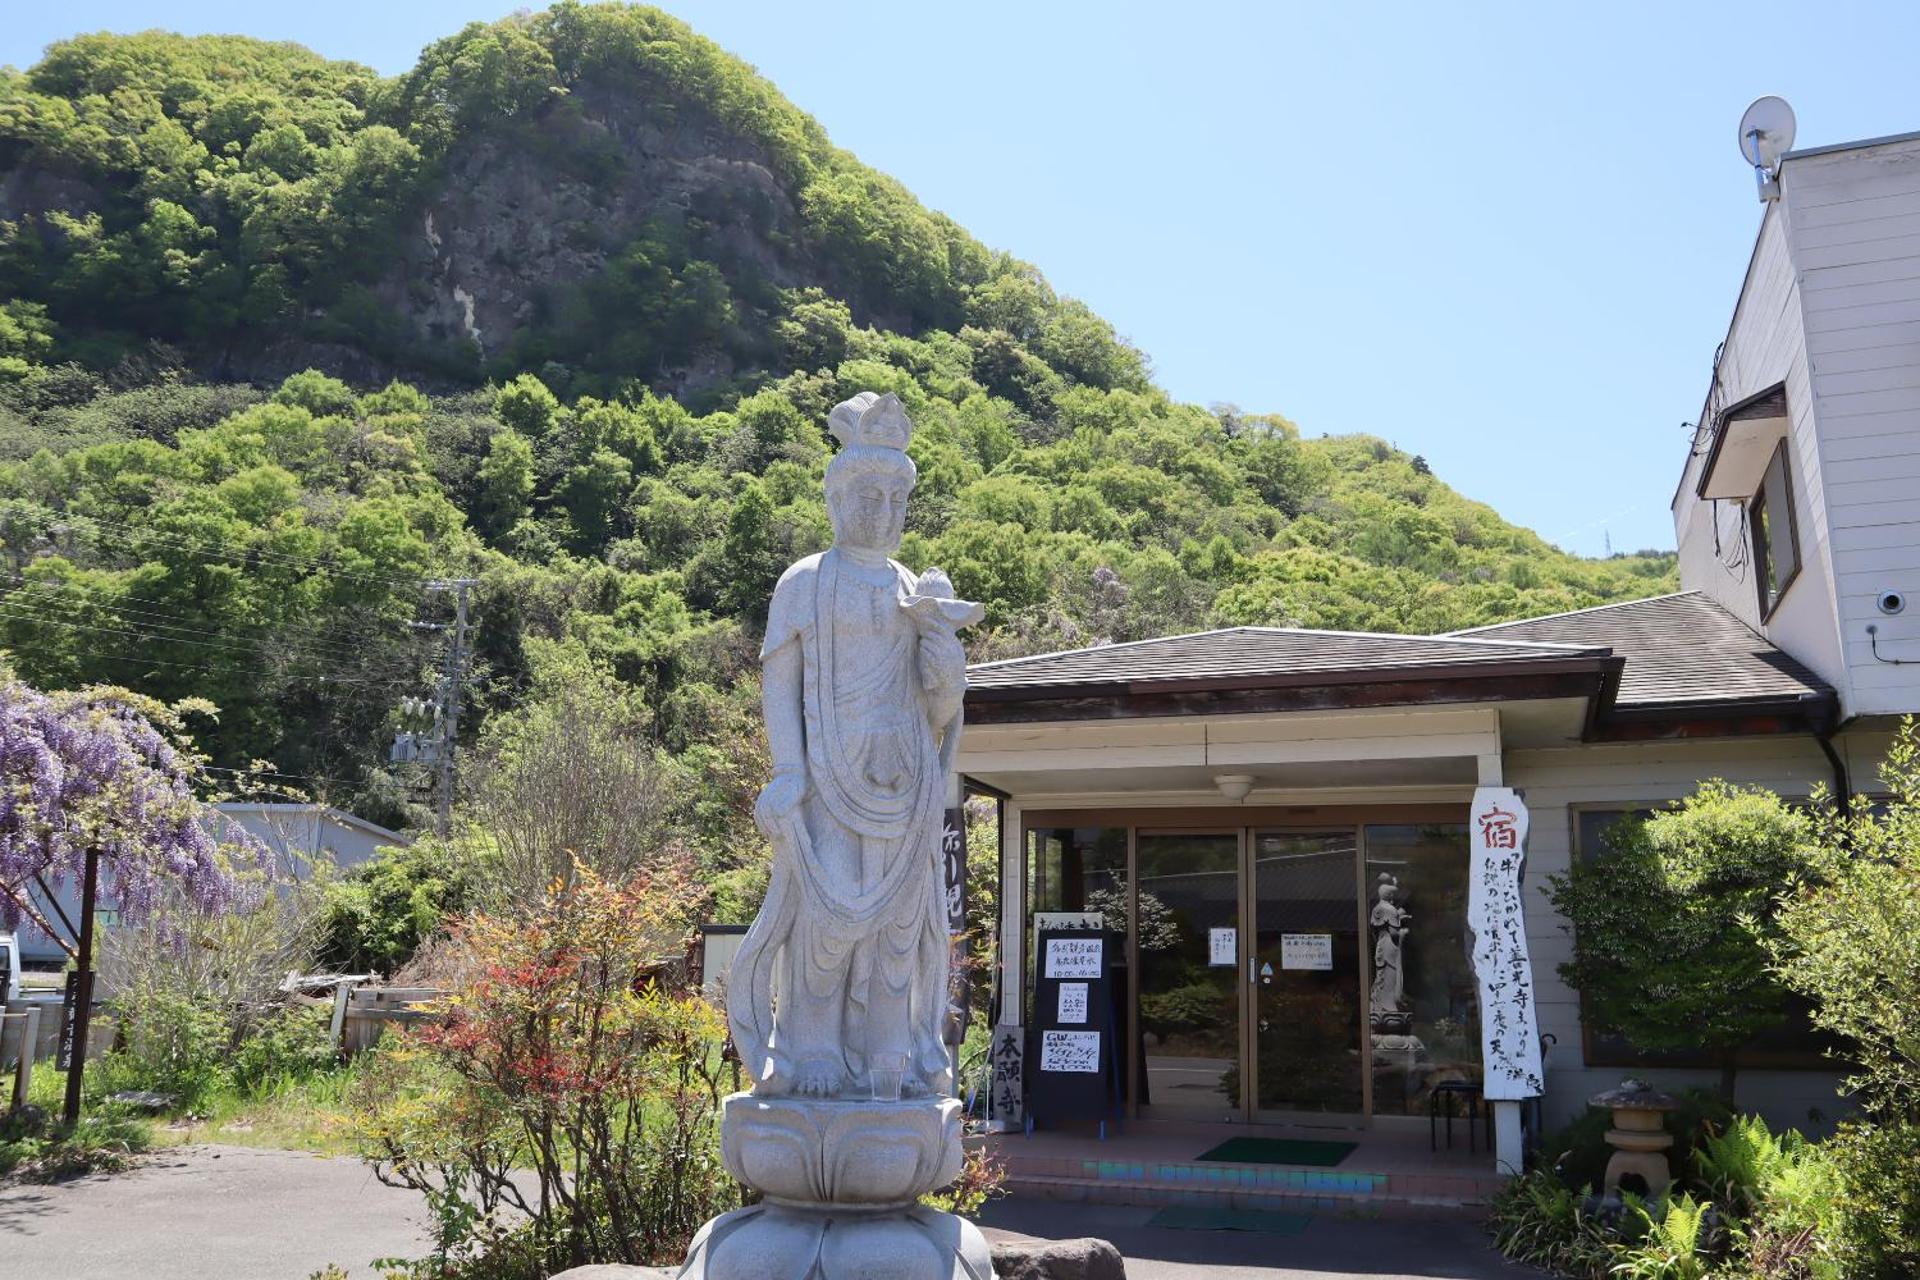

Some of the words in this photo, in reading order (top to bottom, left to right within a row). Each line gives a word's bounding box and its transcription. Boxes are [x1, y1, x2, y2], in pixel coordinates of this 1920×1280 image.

[1479, 804, 1517, 849] 宿
[996, 1033, 1022, 1115] 本願寺
